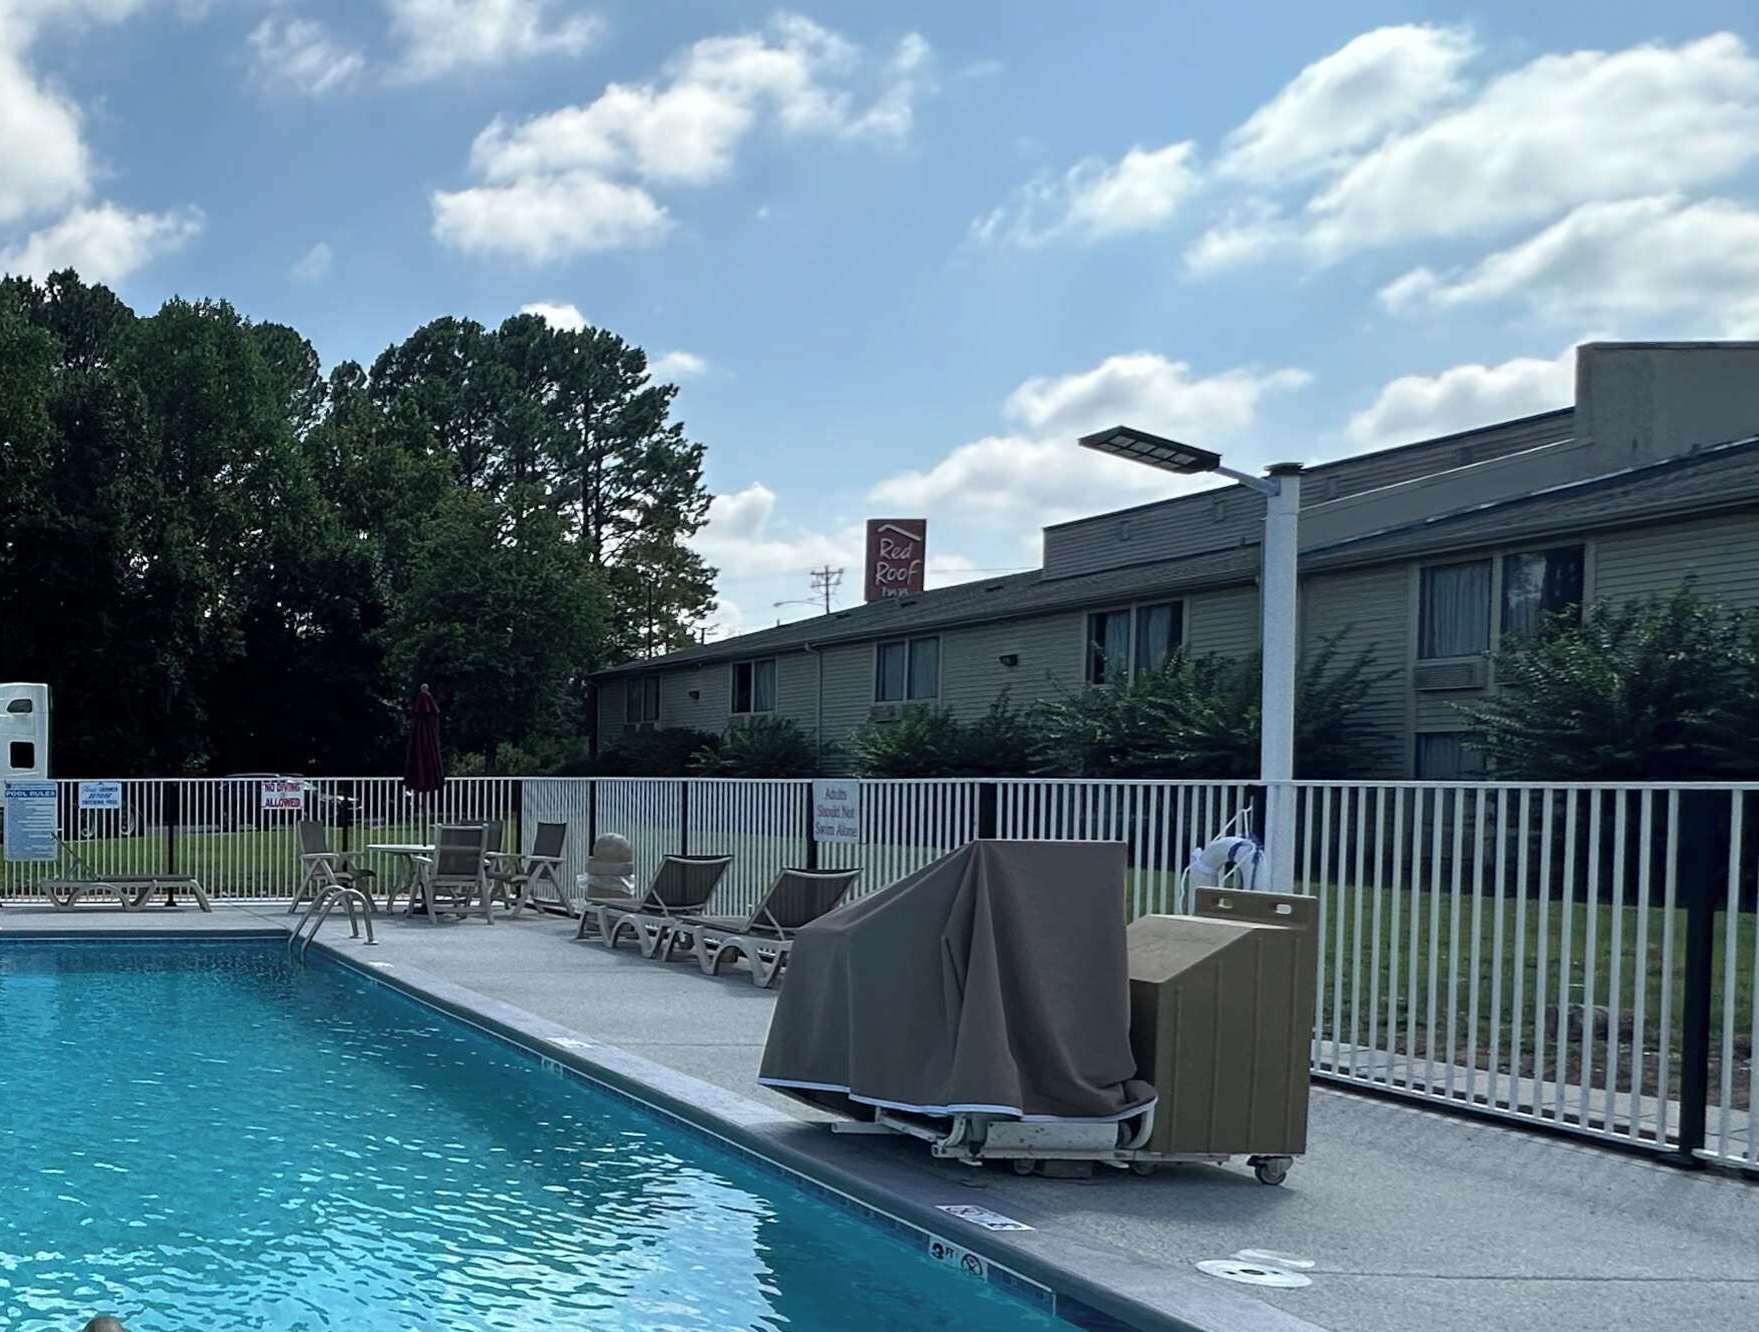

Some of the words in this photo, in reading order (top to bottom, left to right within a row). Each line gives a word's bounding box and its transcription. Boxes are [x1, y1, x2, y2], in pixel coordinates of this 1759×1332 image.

[880, 538, 913, 560] Red
[875, 560, 922, 585] Roof
[882, 586, 908, 597] Inn
[264, 783, 275, 792] NO
[276, 783, 300, 792] DIVING
[265, 797, 301, 807] ALLOWED
[841, 804, 855, 819] Not
[816, 822, 835, 836] Swim
[836, 824, 858, 838] Alone
